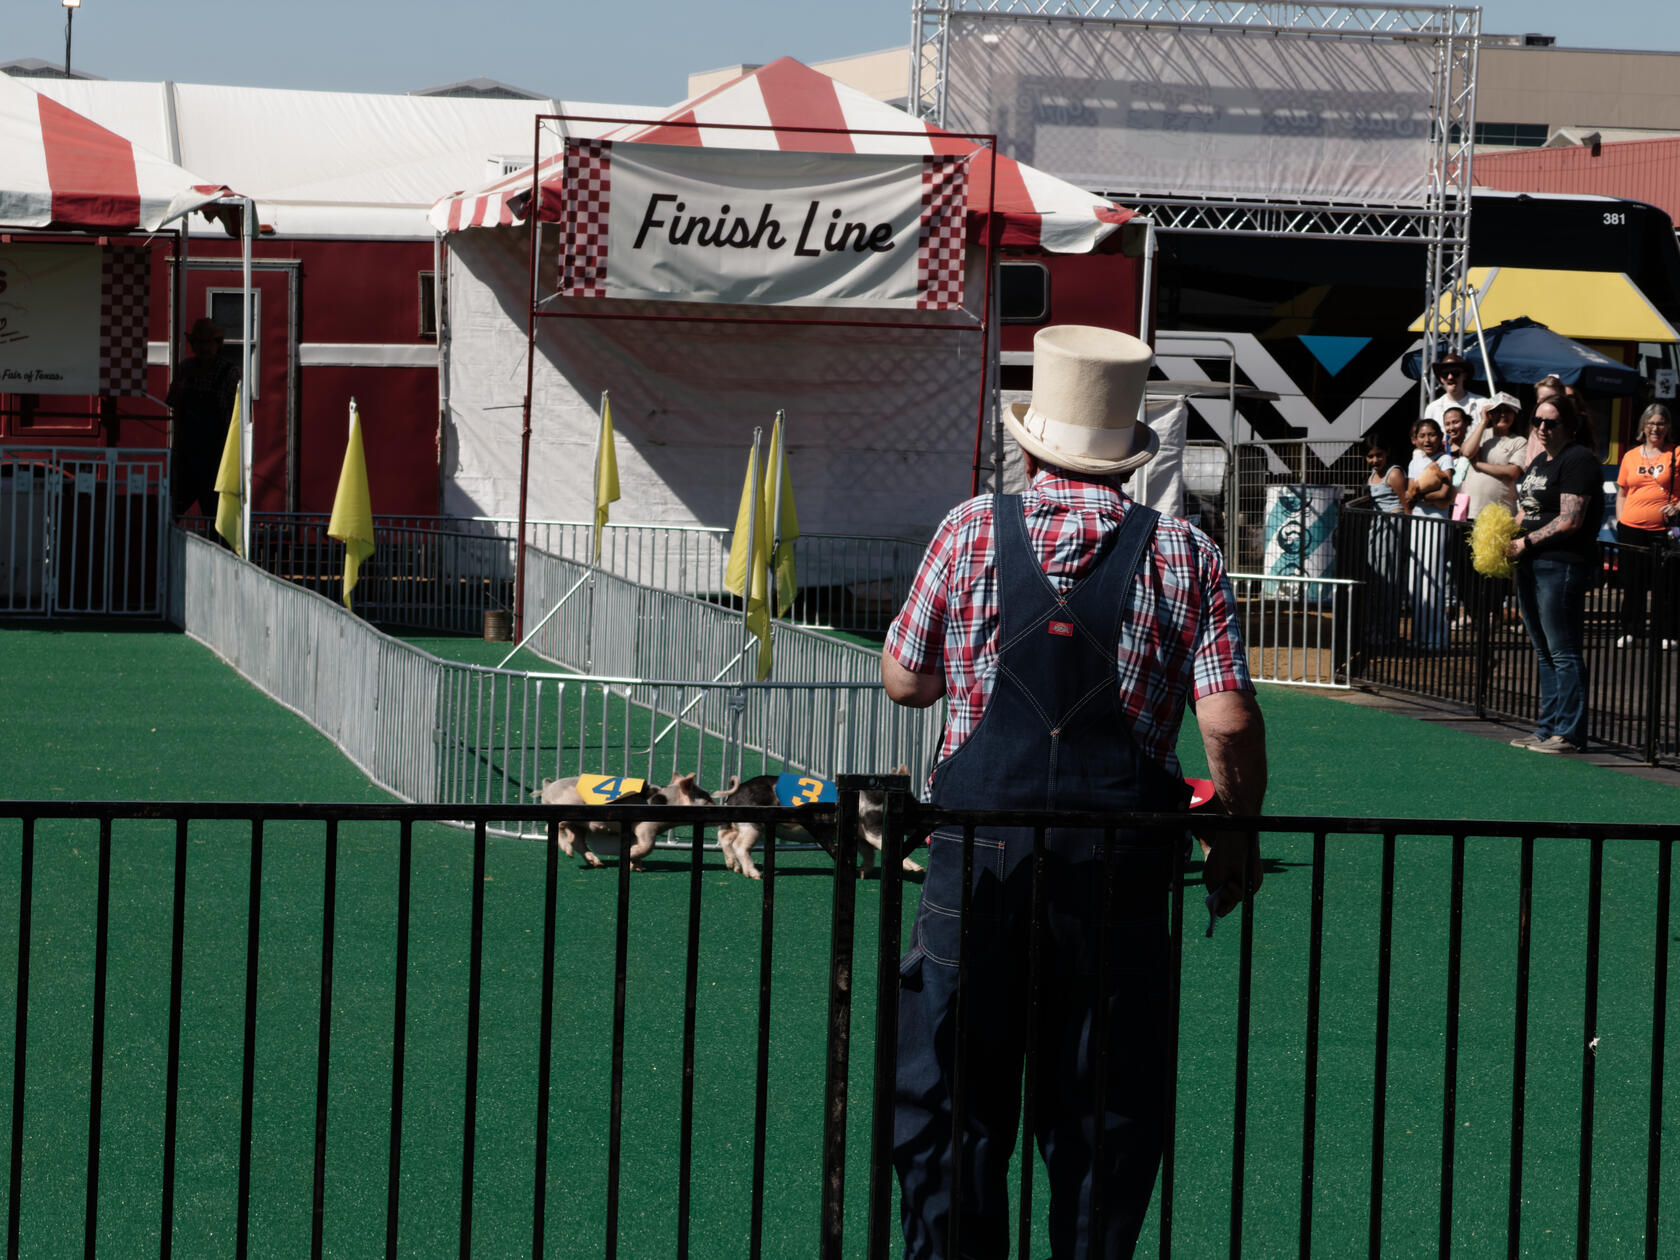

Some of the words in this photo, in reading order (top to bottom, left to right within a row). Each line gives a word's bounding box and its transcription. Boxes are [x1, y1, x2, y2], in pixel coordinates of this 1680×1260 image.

[633, 193, 786, 250] Finish
[794, 200, 895, 257] Line
[1603, 213, 1625, 225] 381
[592, 777, 623, 802] 4
[791, 777, 824, 806] 3
